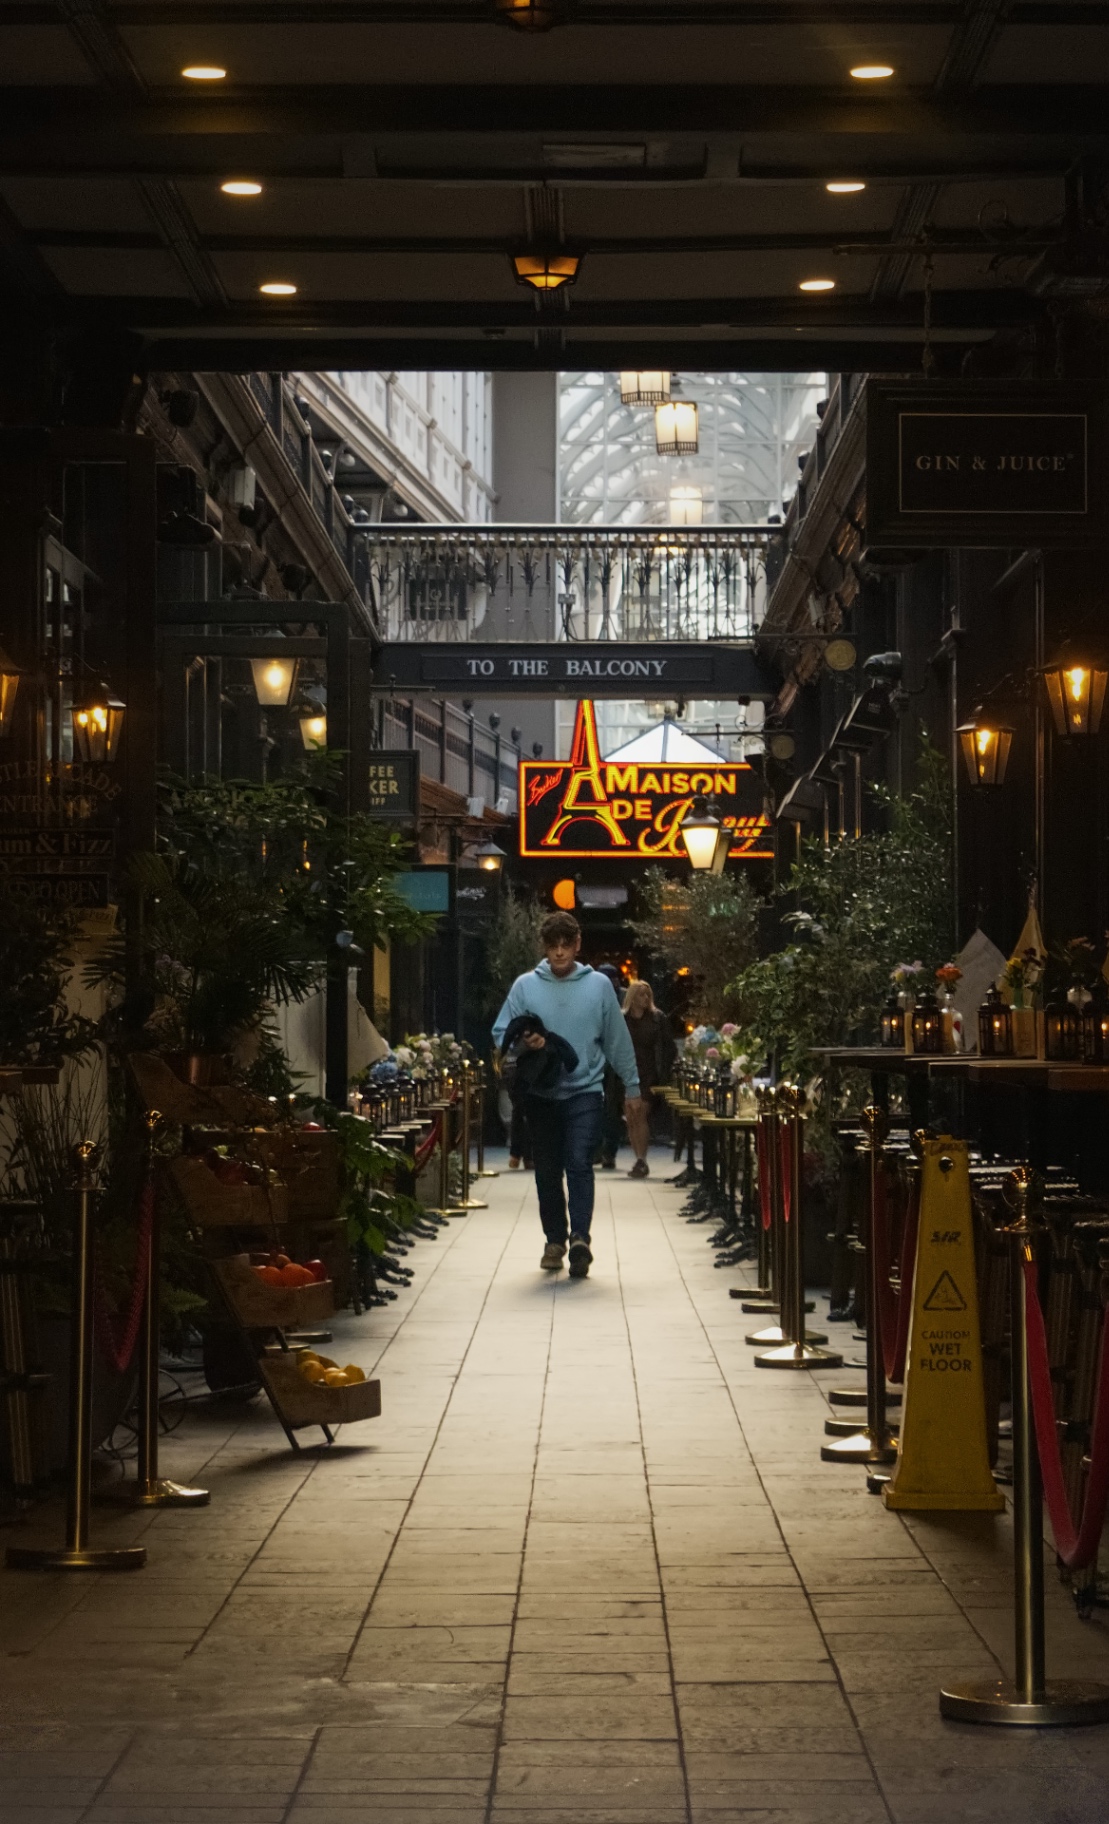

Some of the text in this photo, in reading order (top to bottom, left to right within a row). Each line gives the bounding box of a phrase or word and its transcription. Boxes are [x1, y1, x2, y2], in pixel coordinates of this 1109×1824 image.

[915, 455, 1066, 471] GIN & JUICE
[466, 659, 668, 676] TO THE BALCONY
[605, 765, 737, 795] MAISON
[611, 799, 653, 820] DE
[921, 1330, 971, 1340] CAUTION
[929, 1343, 962, 1355] WET
[920, 1358, 972, 1372] FLOOR
